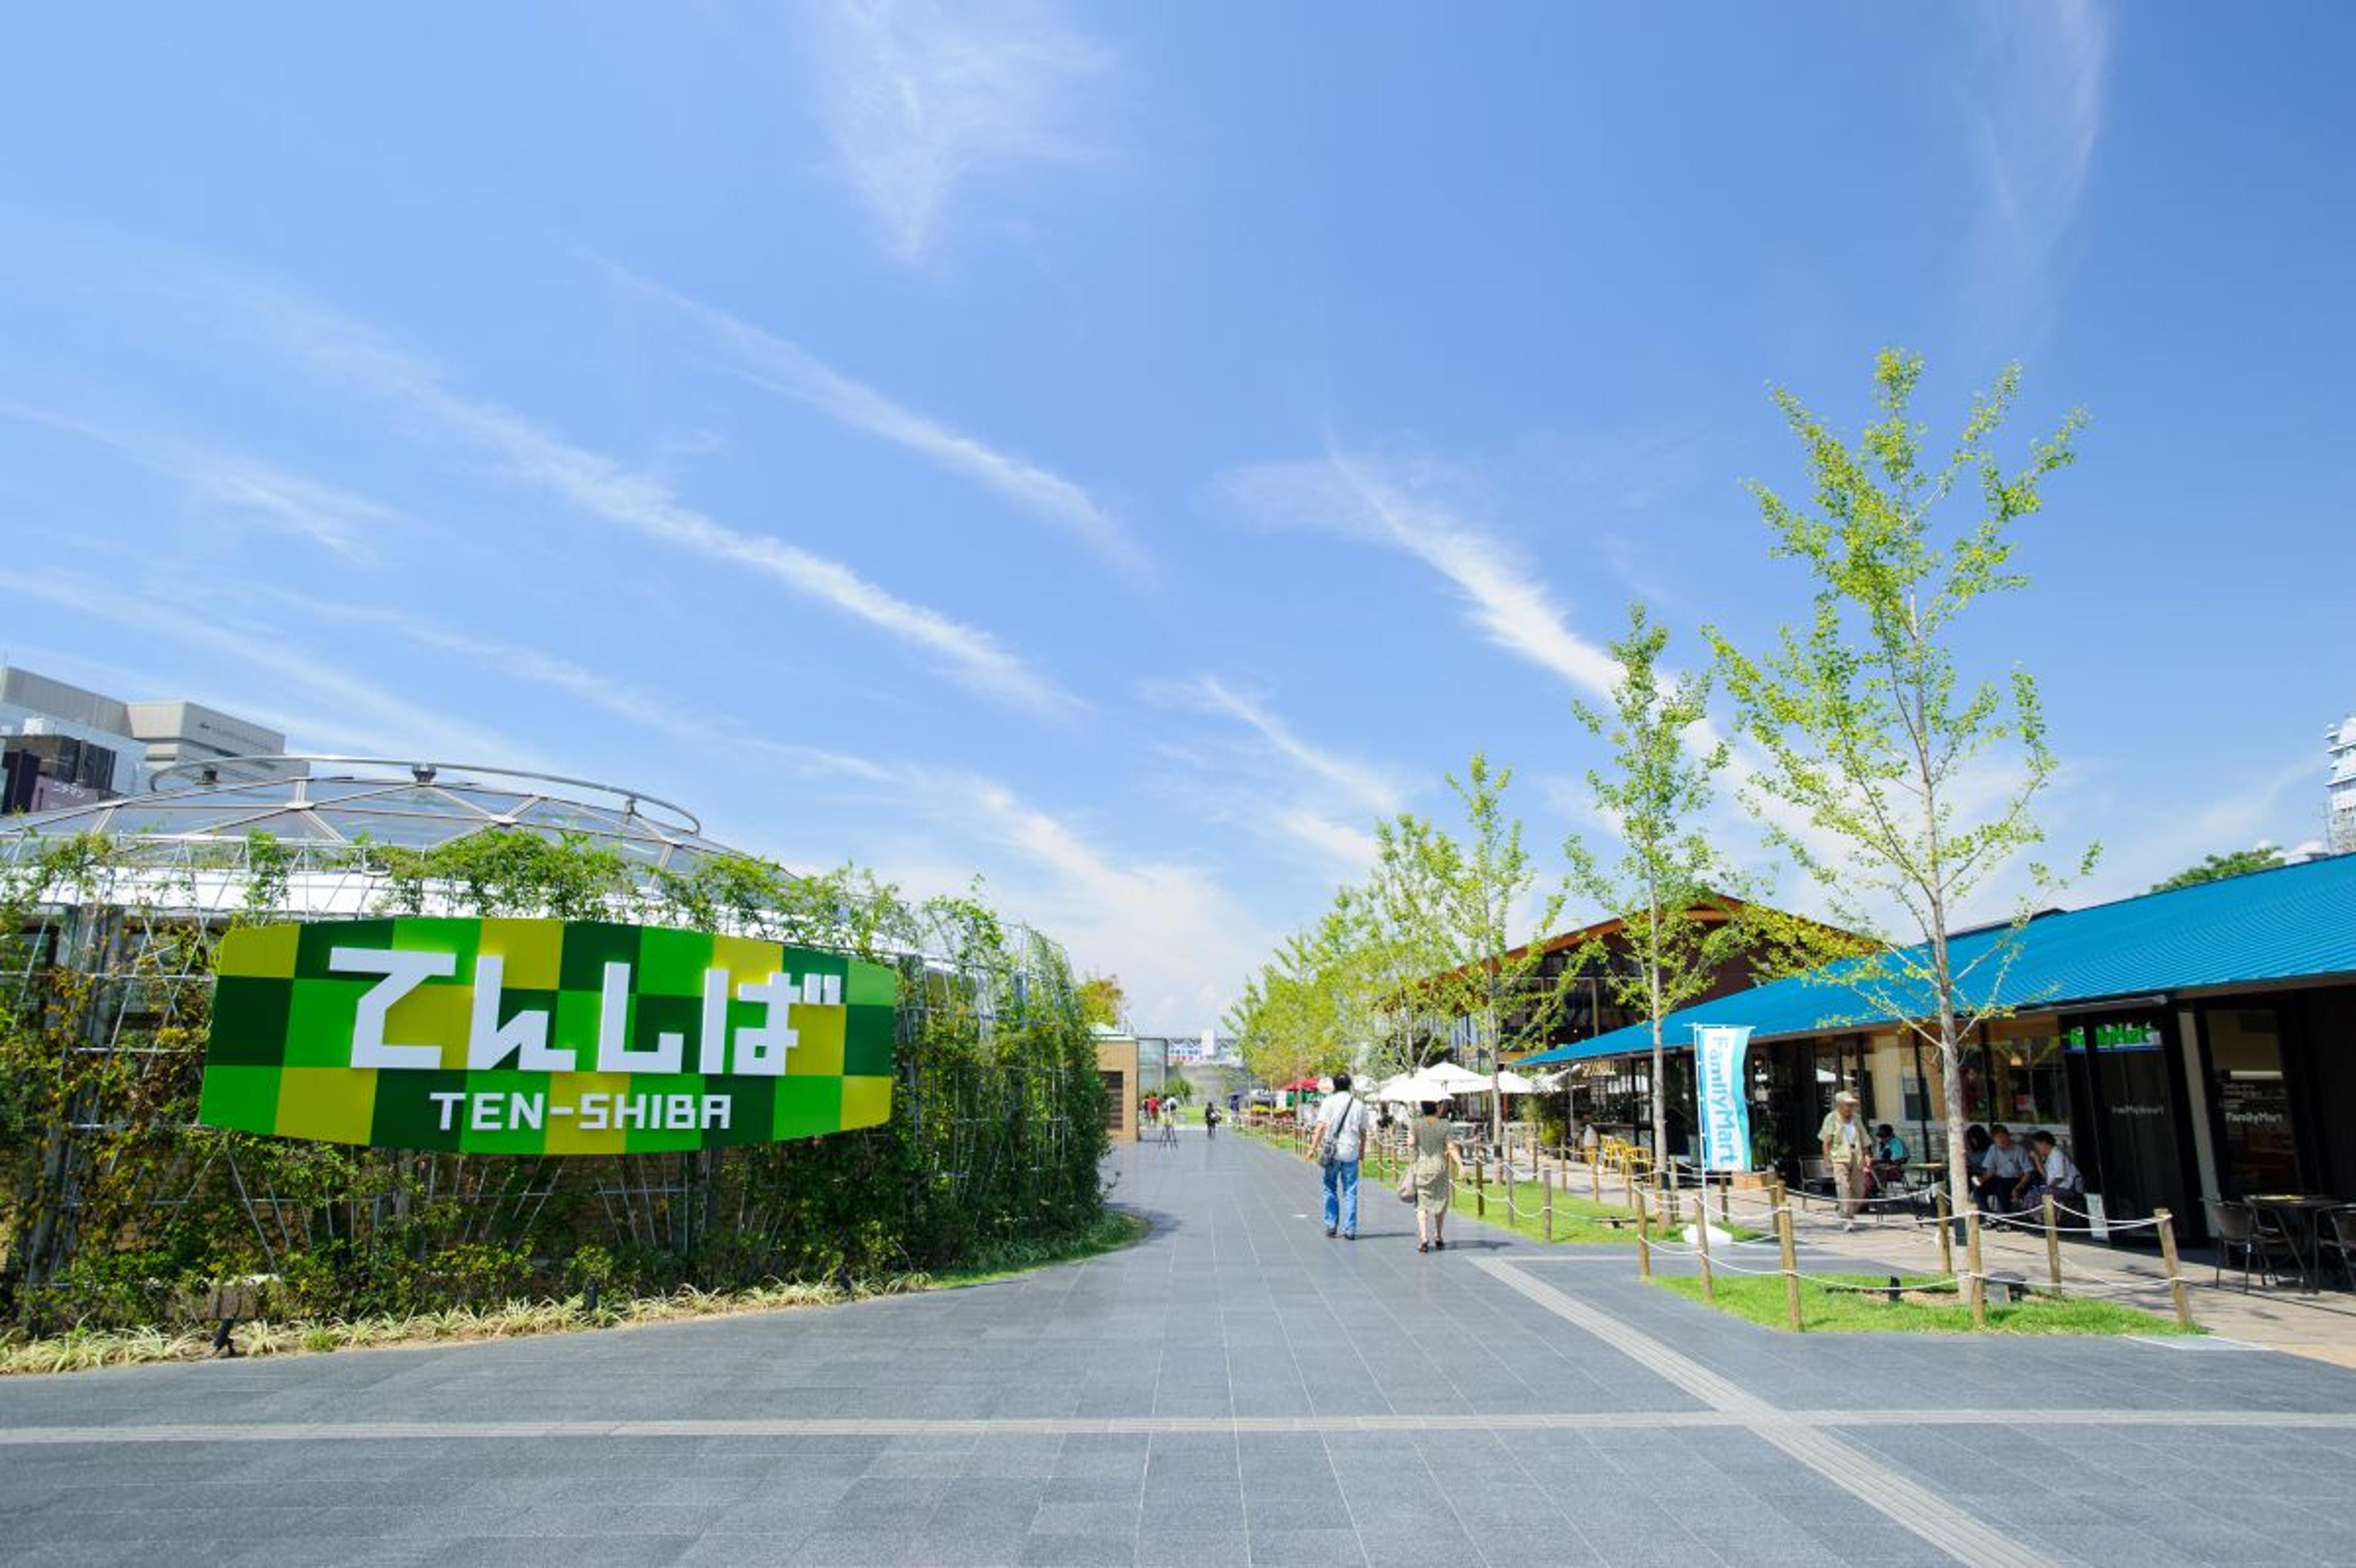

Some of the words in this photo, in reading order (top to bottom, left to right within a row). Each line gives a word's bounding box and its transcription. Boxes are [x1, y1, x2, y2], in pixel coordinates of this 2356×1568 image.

[329, 947, 841, 1075] てんしば
[430, 1091, 732, 1131] TEN-SHIBA
[1709, 1036, 1738, 1163] FamilyMart
